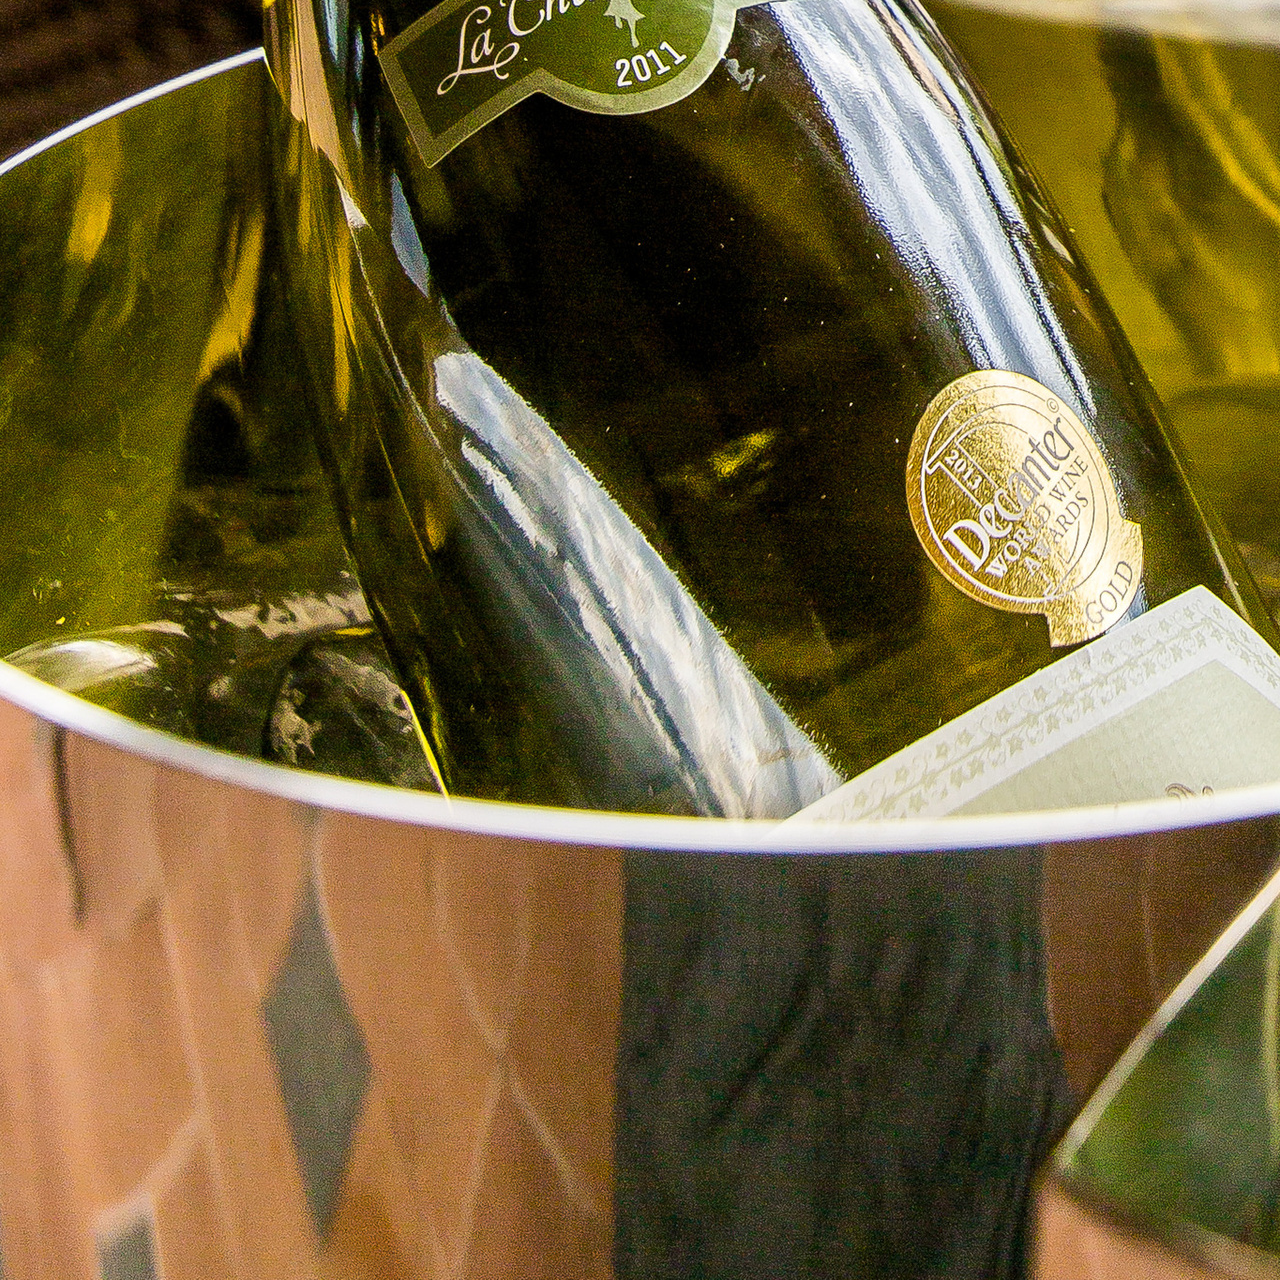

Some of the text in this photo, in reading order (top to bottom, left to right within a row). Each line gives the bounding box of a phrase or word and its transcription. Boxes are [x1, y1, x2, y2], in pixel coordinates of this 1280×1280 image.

[437, 5, 520, 96] La
[615, 40, 687, 89] 2011
[943, 417, 1075, 572] Decanter
[944, 449, 984, 491] 2013
[984, 454, 1089, 579] WORLD WINE
[1023, 492, 1089, 577] AWARDS
[1085, 559, 1133, 625] GOLD
